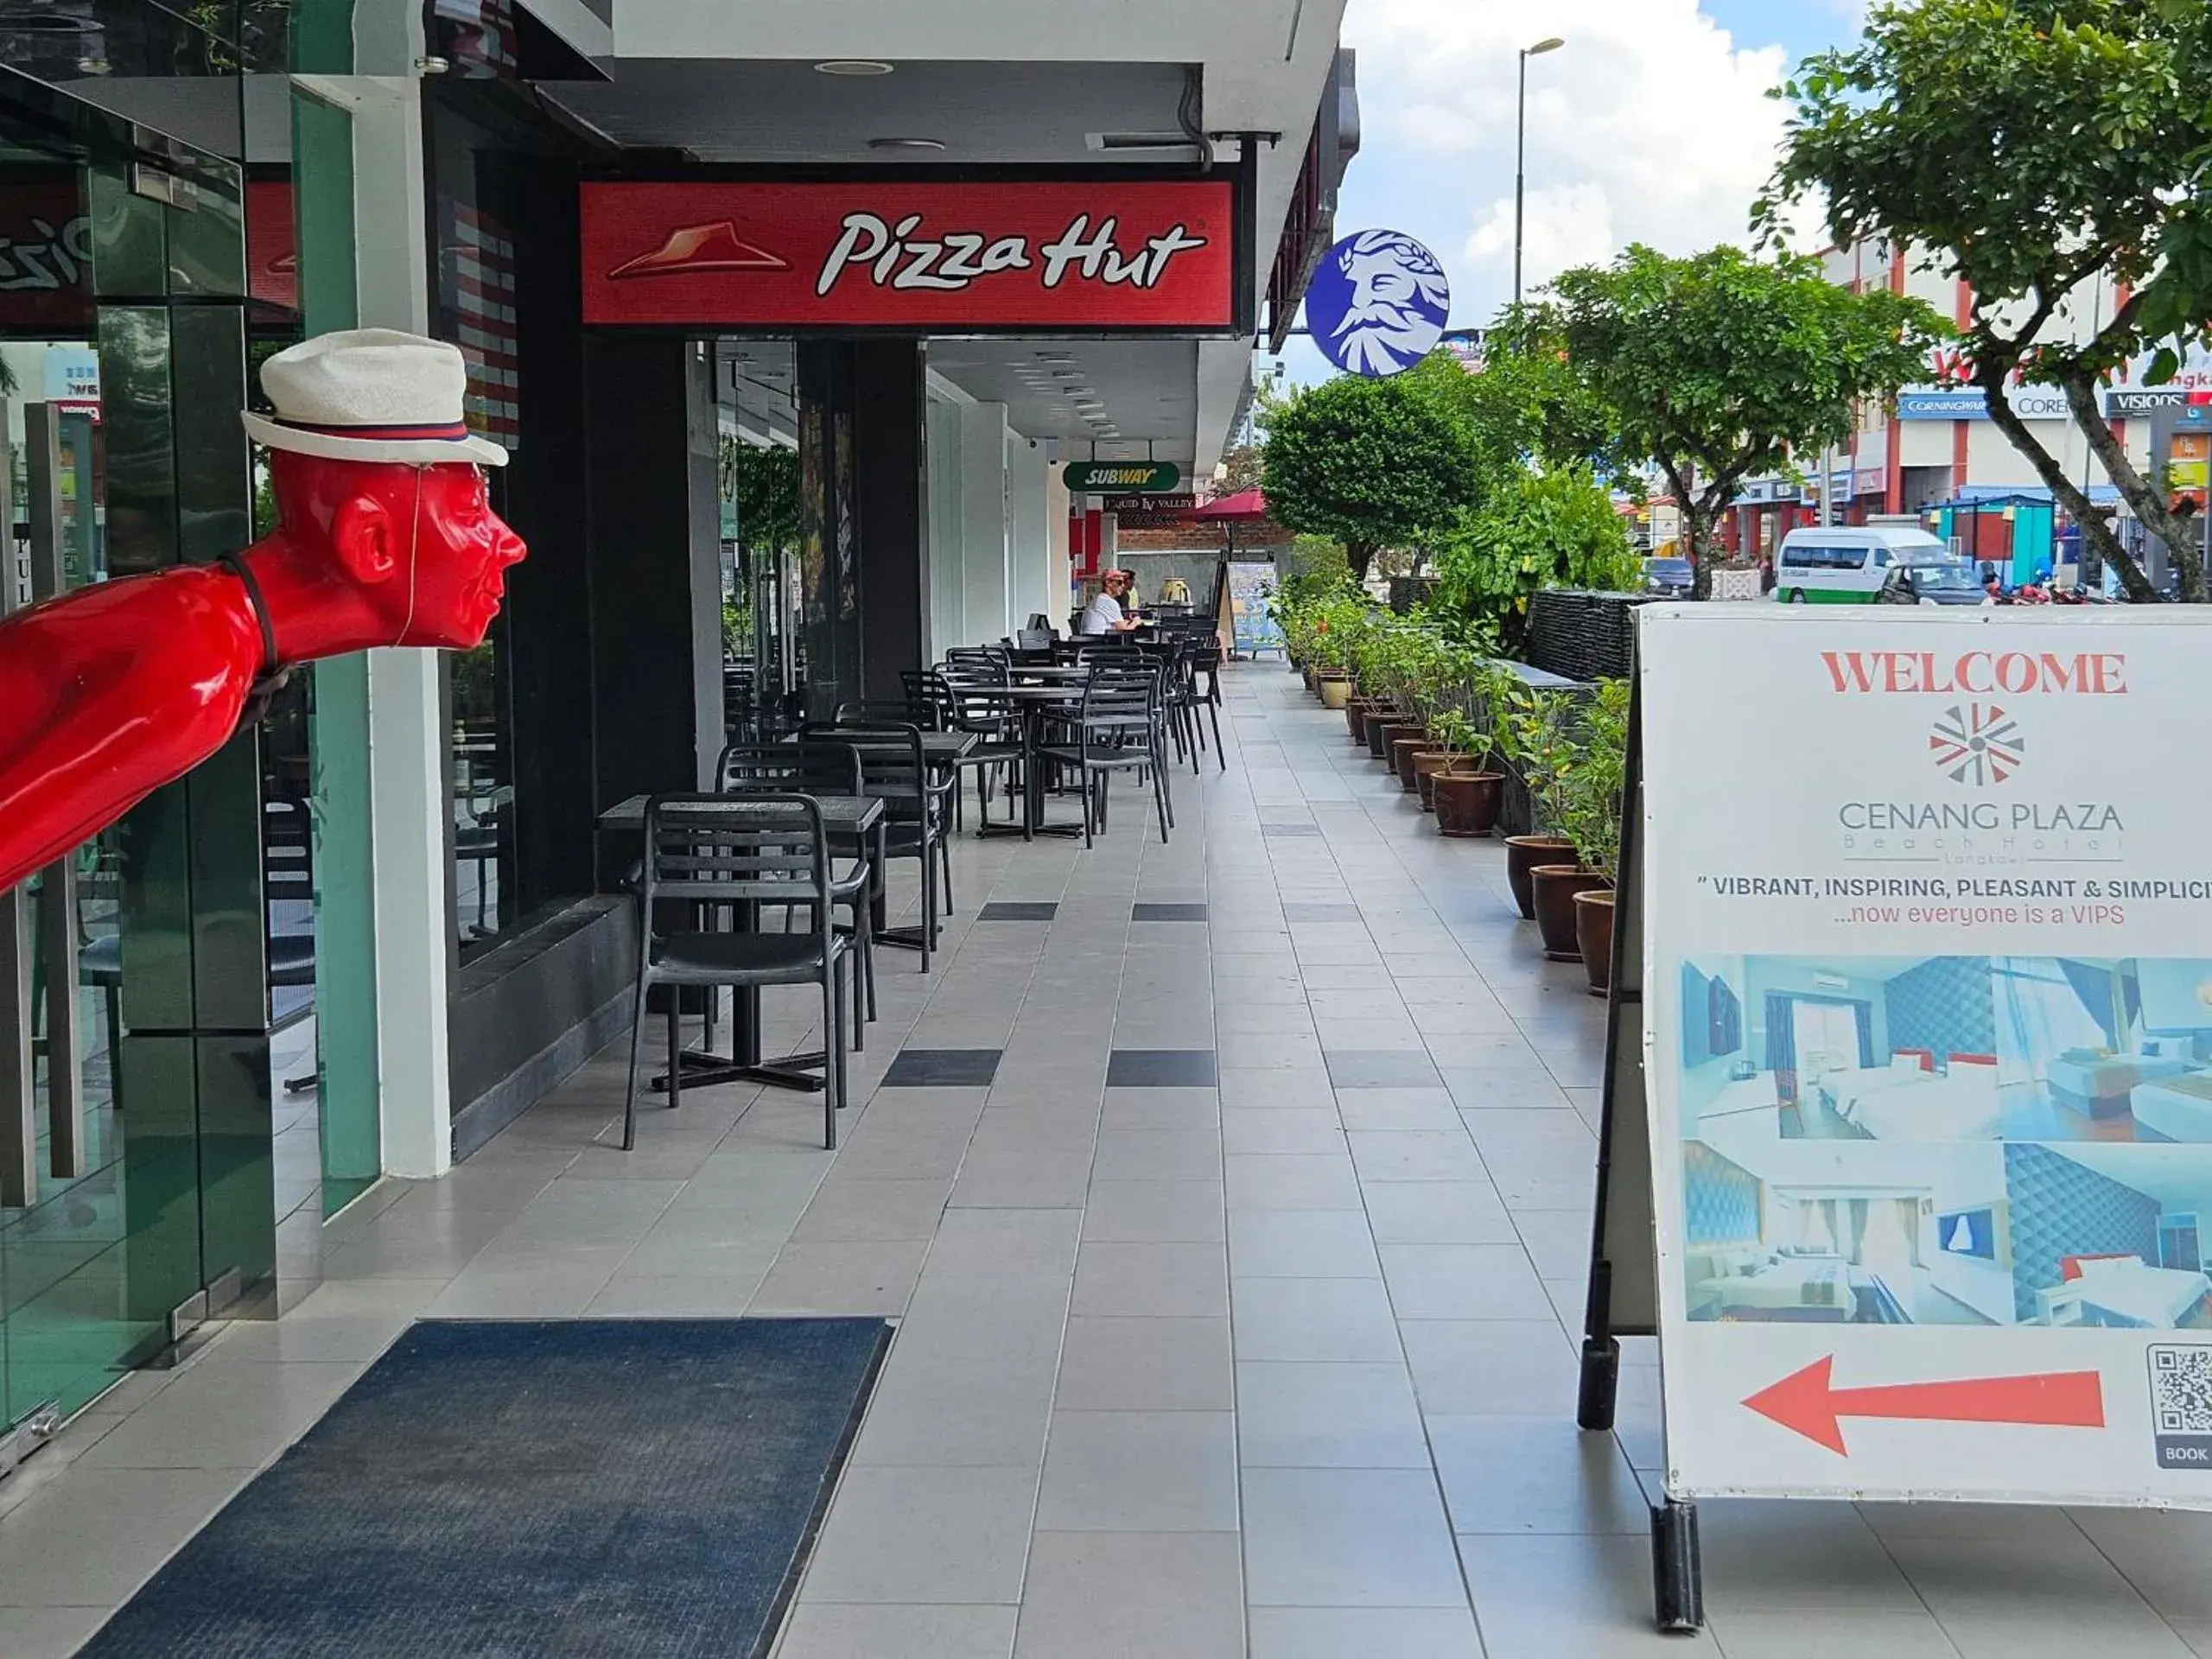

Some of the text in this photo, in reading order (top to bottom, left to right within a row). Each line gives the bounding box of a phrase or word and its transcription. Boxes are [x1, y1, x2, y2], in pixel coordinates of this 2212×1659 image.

[815, 213, 1205, 295] Pizza Hut
[1907, 400, 1986, 412] CORNINGWAR
[2018, 397, 2068, 414] CORE
[1085, 468, 1157, 485] SUBWAY
[1158, 499, 1192, 508] VALLEY
[1821, 651, 2128, 694] WELCOME
[1839, 803, 2124, 831] CENANG PLAZA
[1844, 835, 2123, 850] Beach Hotel
[1713, 877, 1820, 899] VIBRANT,
[1825, 878, 1951, 899] INSPIRING,
[1957, 880, 2076, 898] PLEASANT
[2083, 880, 2102, 898] &
[2107, 880, 2212, 899] SIMPLICI
[1907, 906, 2018, 926] everyone
[2025, 904, 2044, 924] is
[2051, 908, 2064, 924] a
[2071, 905, 2125, 925] VIPS
[2165, 1446, 2209, 1461] BOOK
